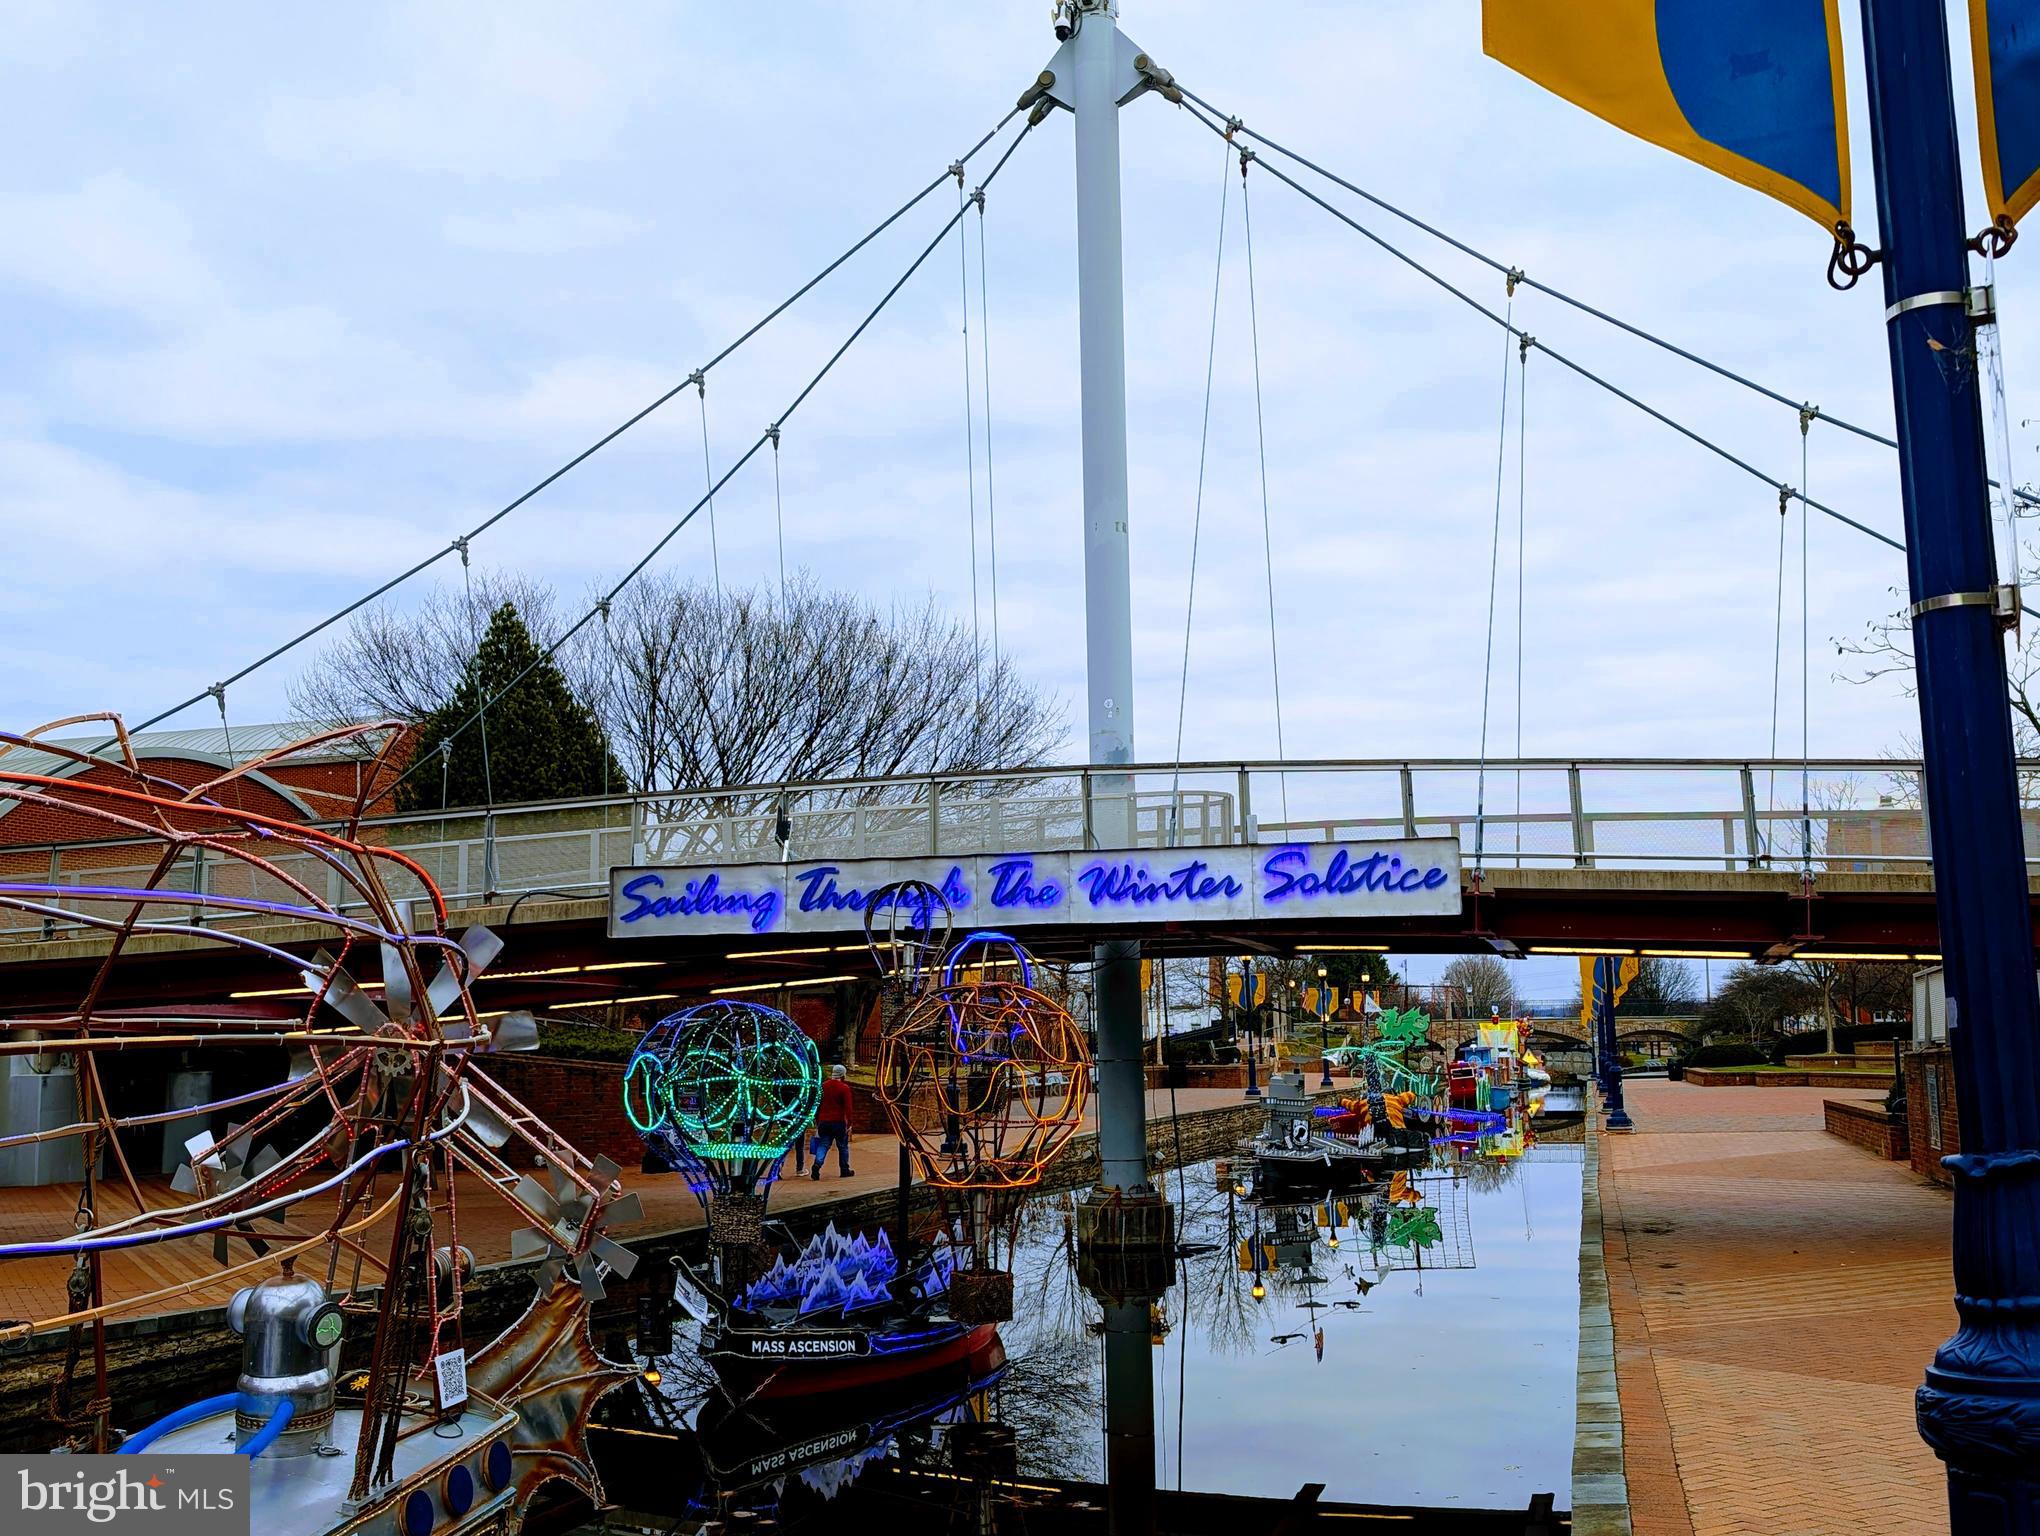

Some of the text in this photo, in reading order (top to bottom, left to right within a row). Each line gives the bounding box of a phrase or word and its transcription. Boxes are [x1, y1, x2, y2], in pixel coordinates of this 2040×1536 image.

[620, 873, 776, 930] Sailing
[986, 860, 1060, 908] The
[1079, 860, 1242, 903] Winter
[1263, 849, 1449, 900] Solstice
[751, 1339, 856, 1353] MASS ASCENSION
